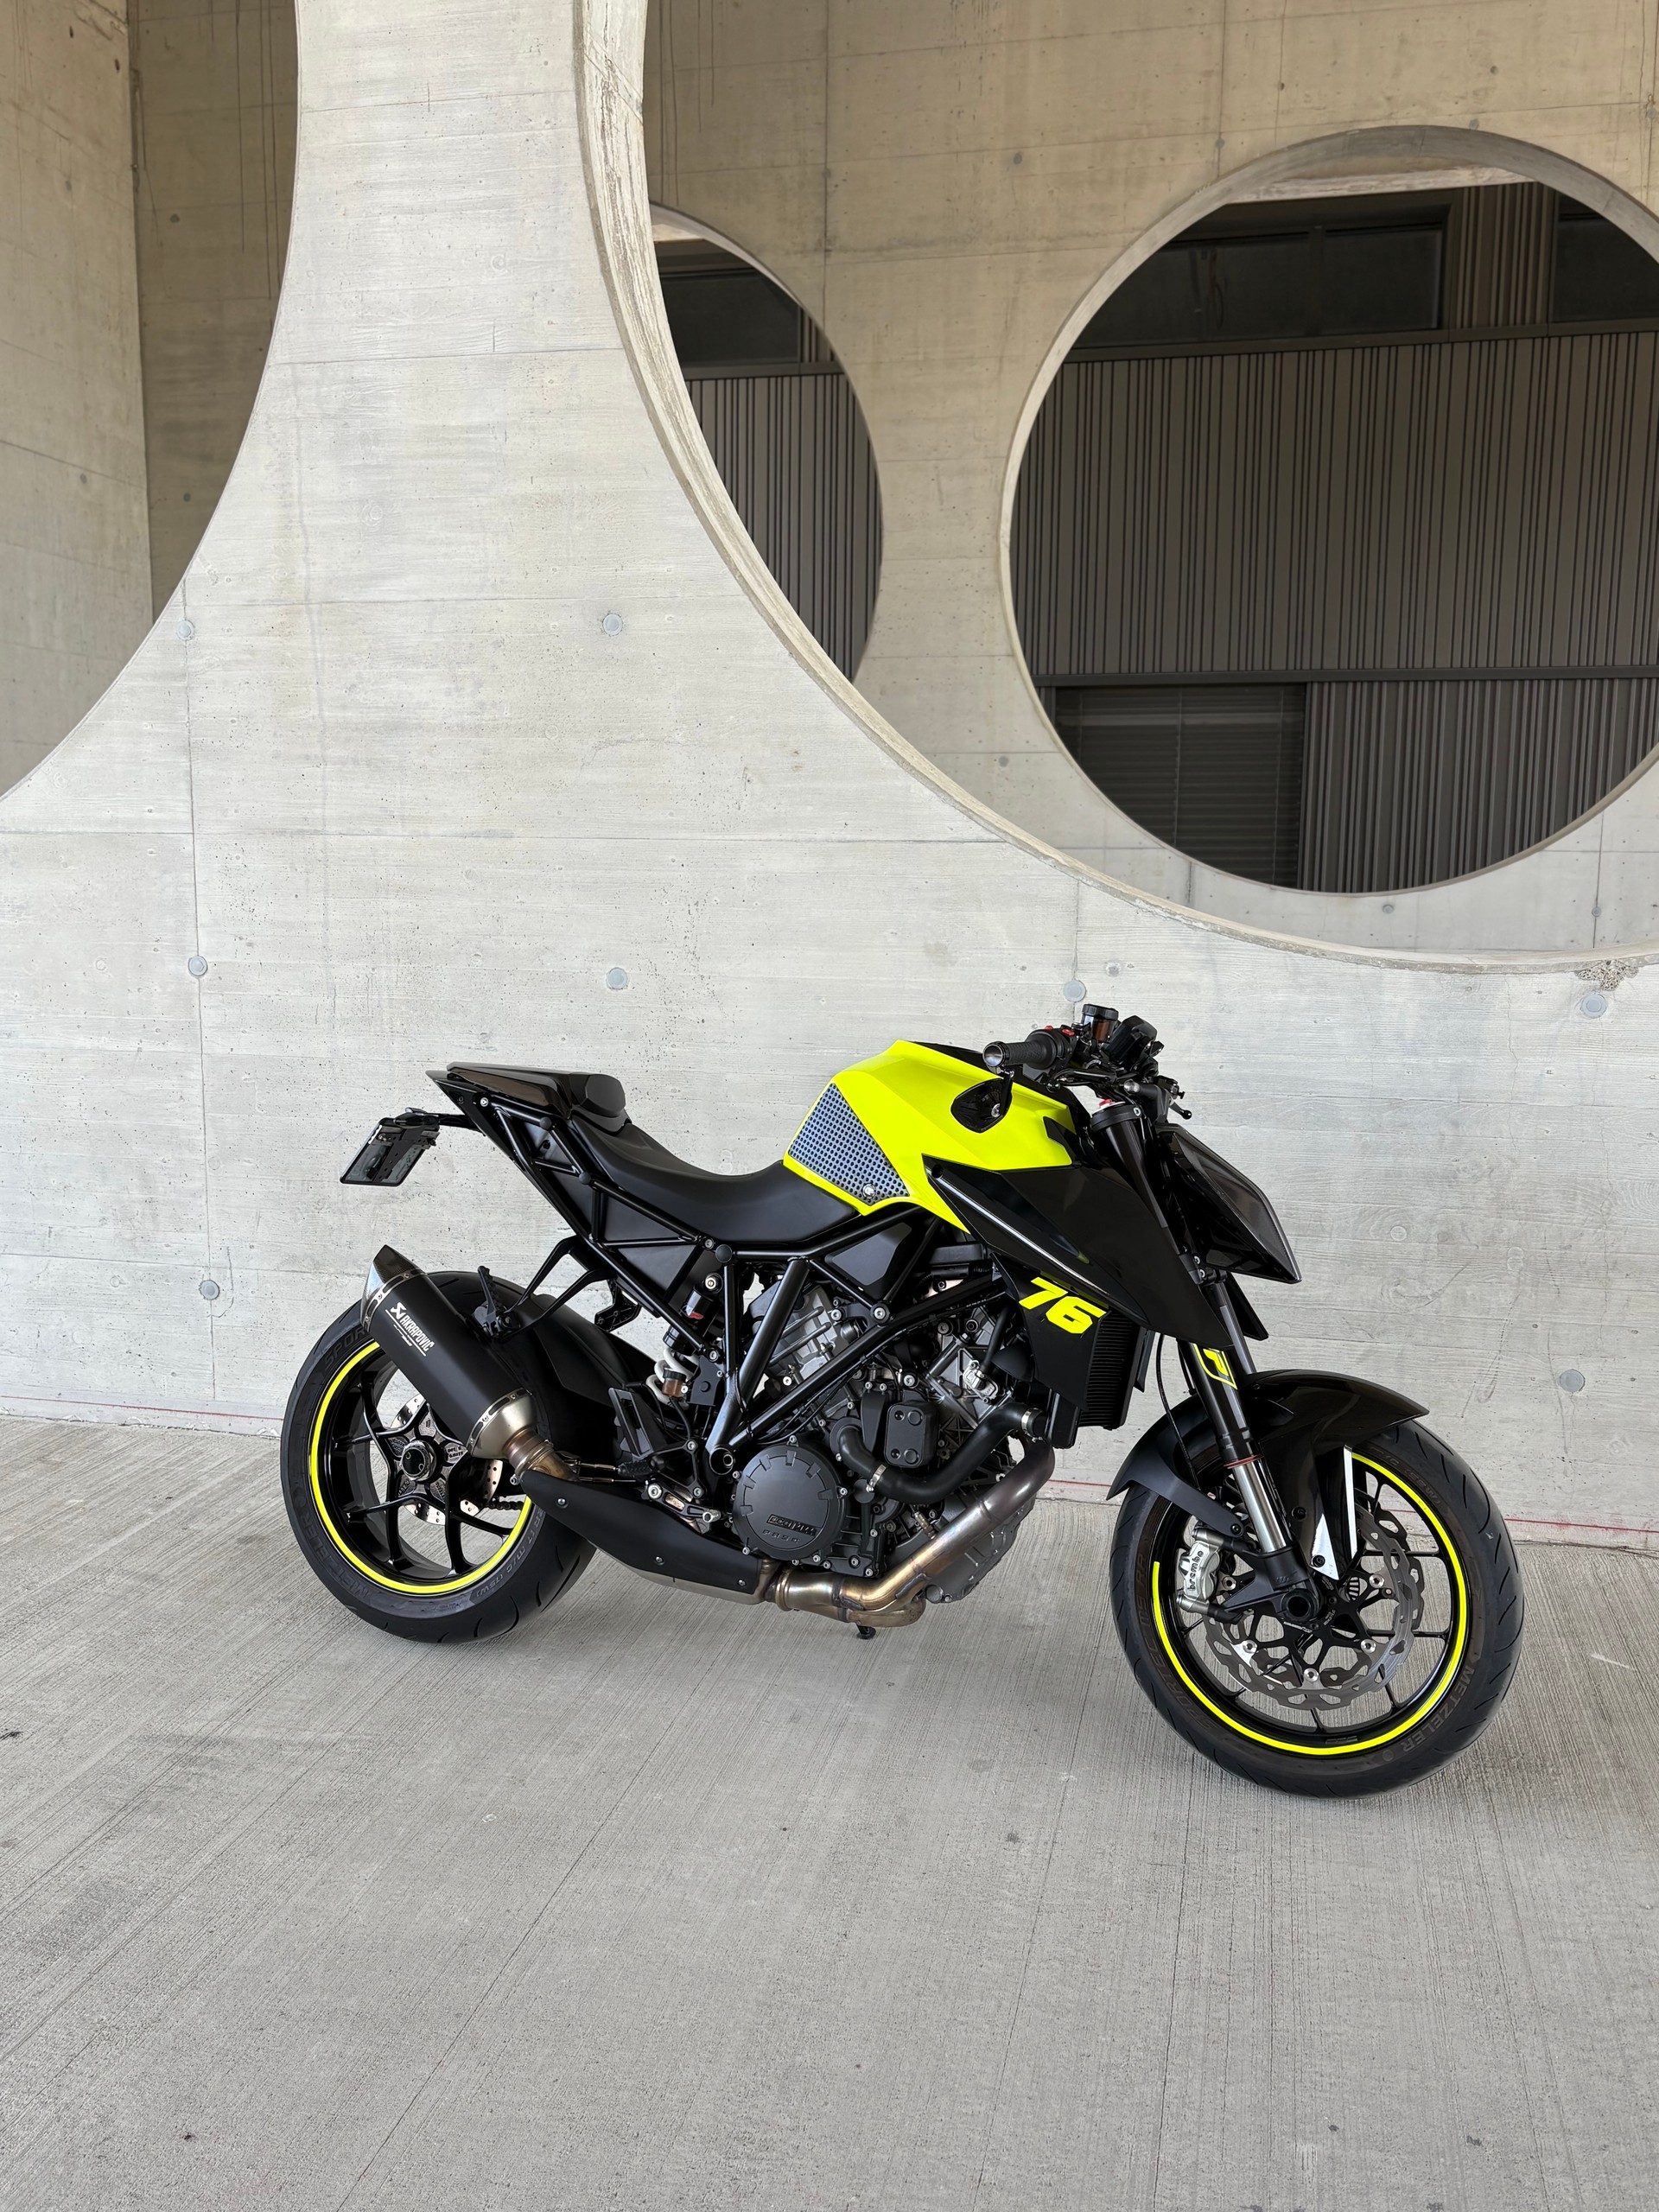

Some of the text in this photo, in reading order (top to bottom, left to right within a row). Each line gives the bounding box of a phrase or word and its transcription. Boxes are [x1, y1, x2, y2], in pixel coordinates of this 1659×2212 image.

[1019, 1276, 1107, 1335] 76
[1187, 1550, 1205, 1591] brembo
[1142, 1635, 1215, 1732] SPORTEC
[1398, 1665, 1476, 1753] METZELER
